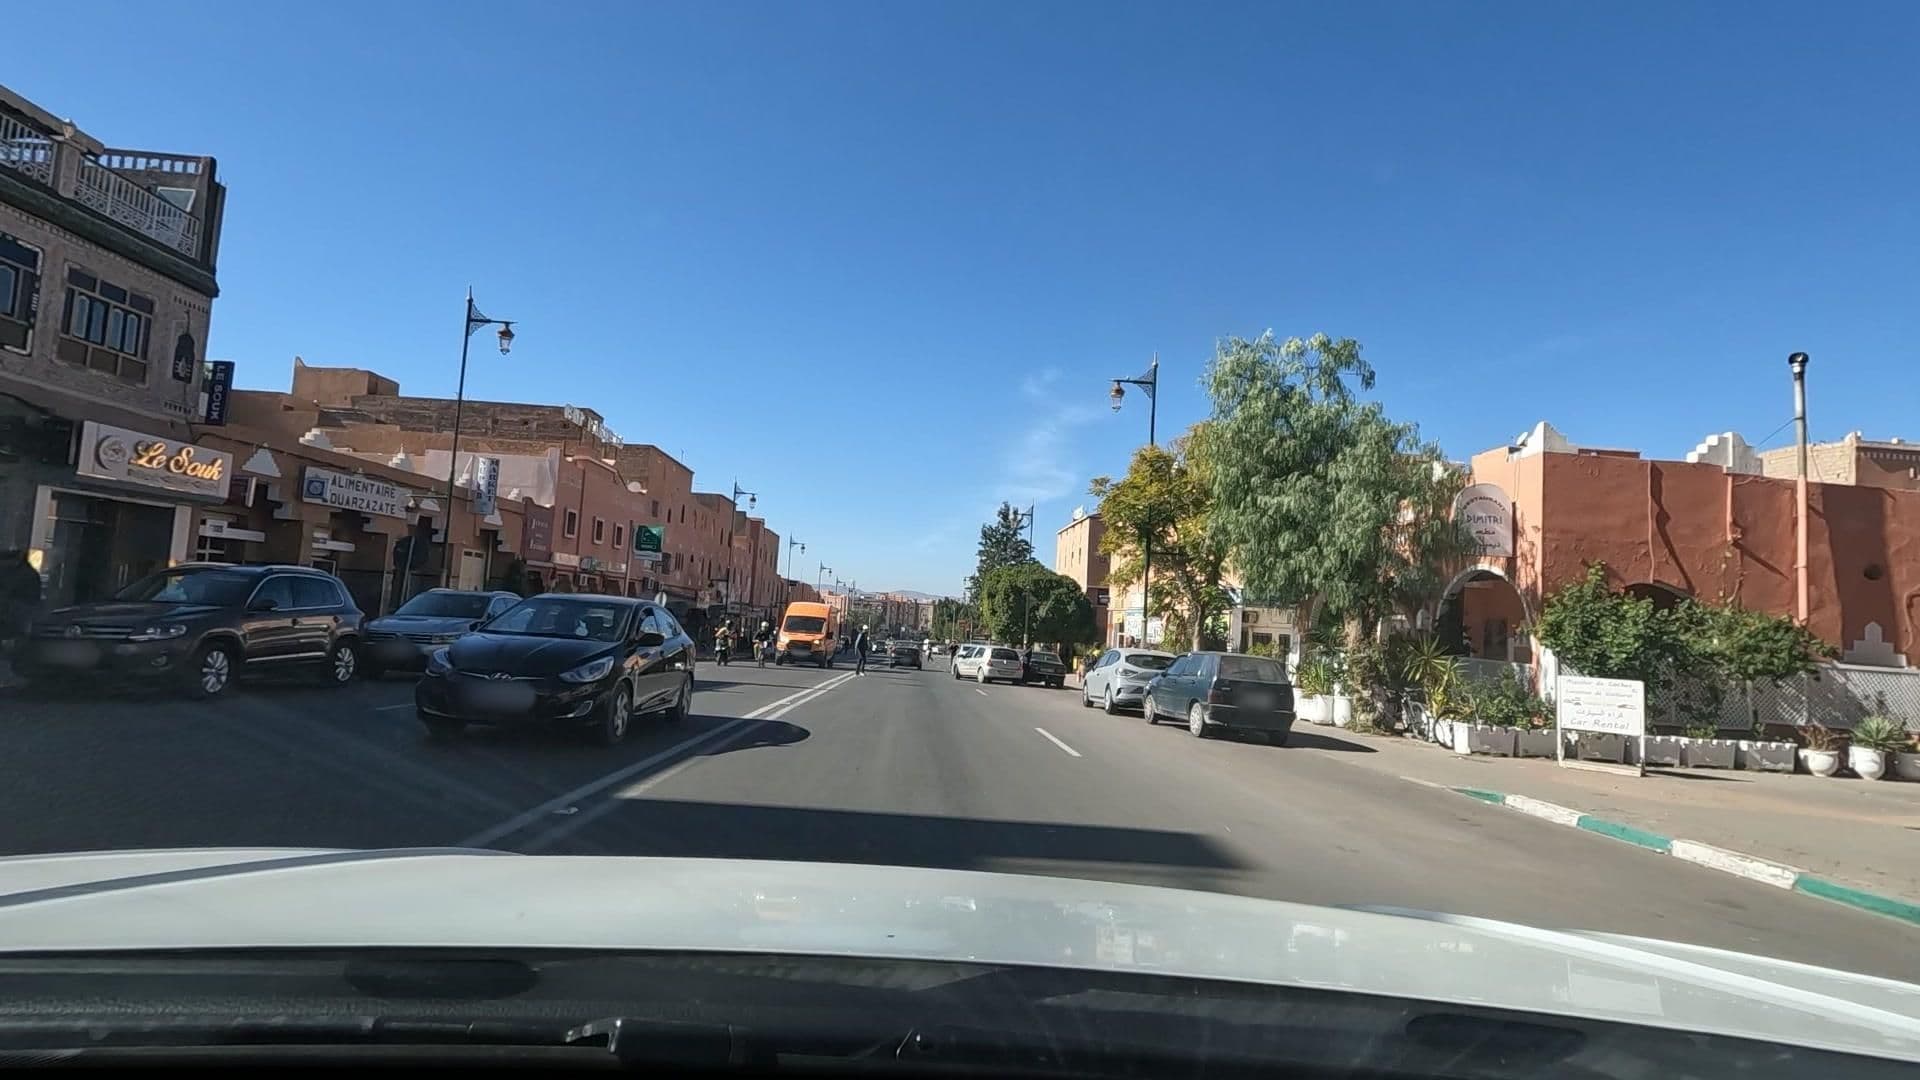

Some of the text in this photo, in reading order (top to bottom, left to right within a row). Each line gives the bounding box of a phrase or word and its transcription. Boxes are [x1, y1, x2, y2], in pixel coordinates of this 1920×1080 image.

[210, 365, 227, 420] LE SOUK
[130, 441, 224, 481] Le Souk
[330, 474, 396, 499] ALIMENTAIRE
[1466, 514, 1503, 525] DIMITRI
[1569, 718, 1630, 730] Car Rental
